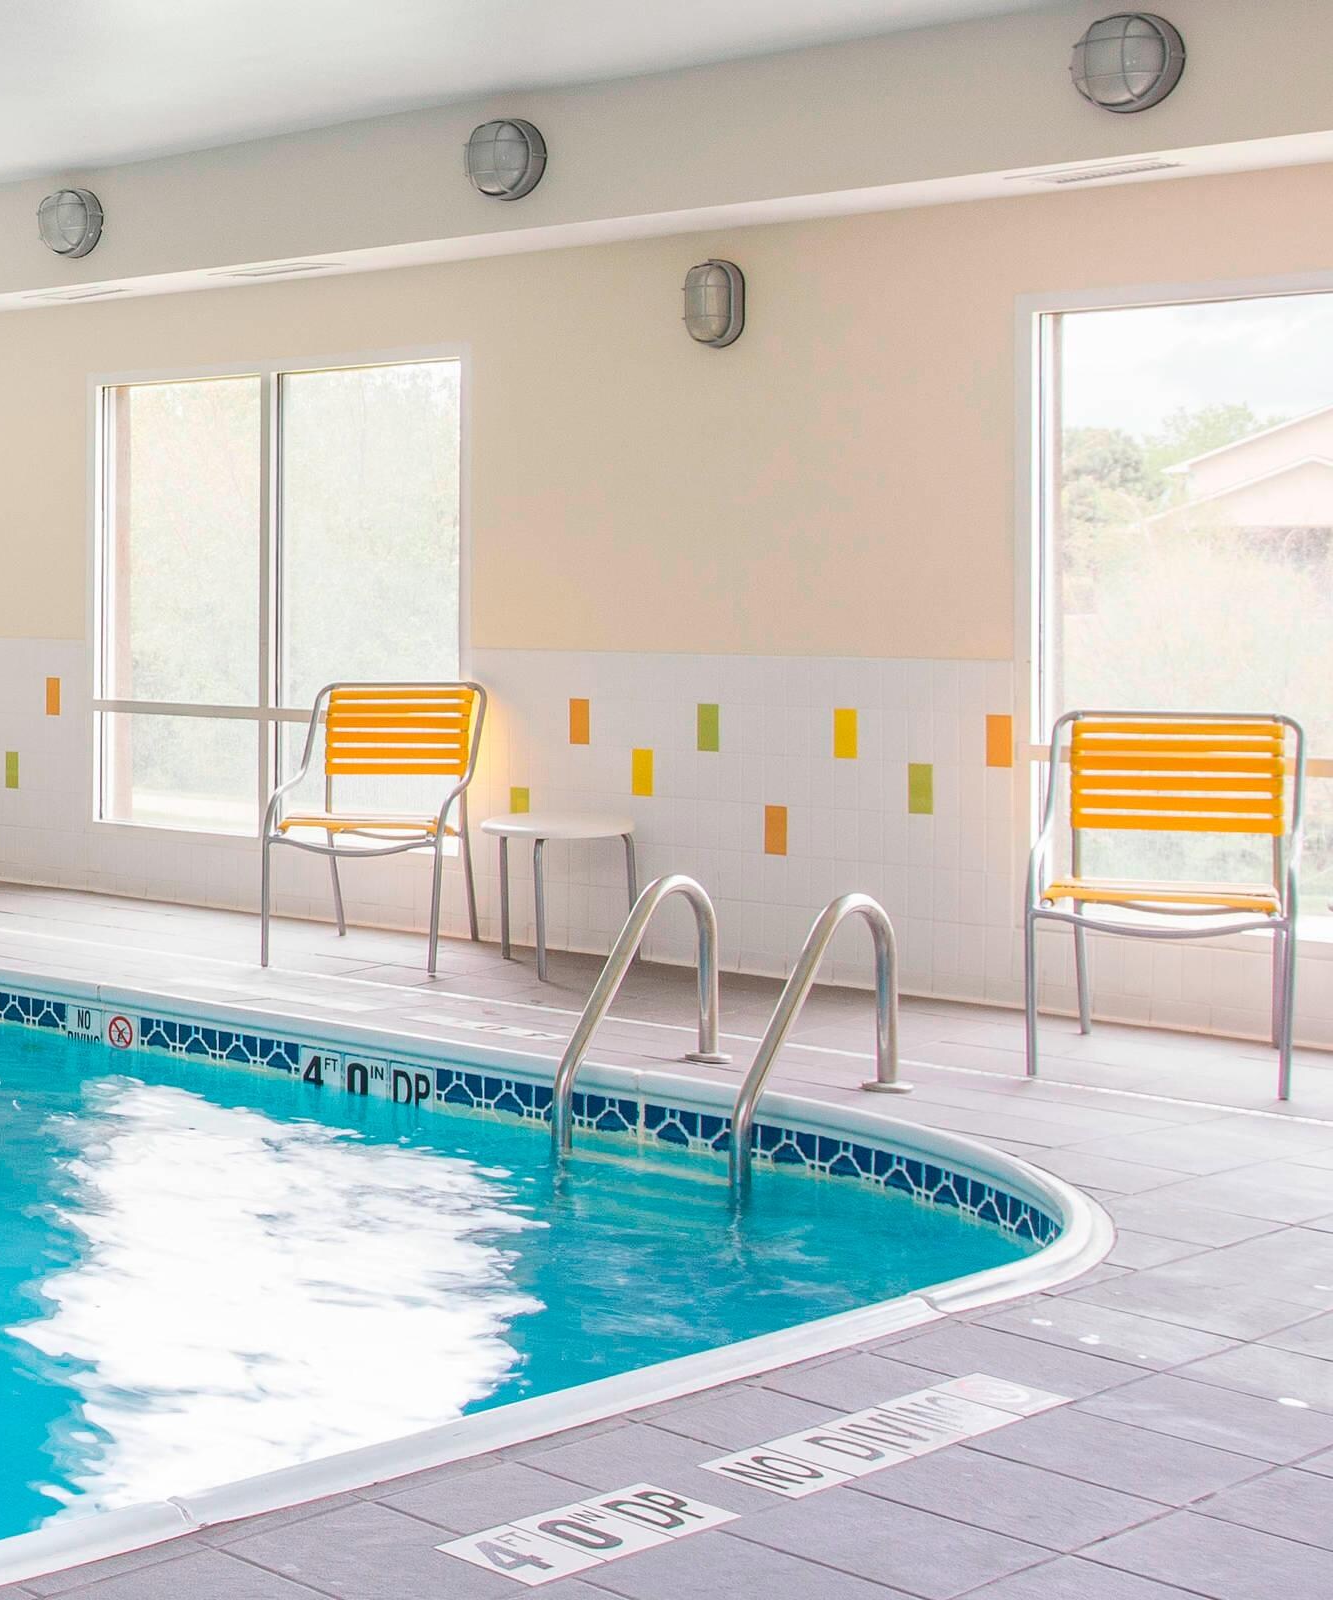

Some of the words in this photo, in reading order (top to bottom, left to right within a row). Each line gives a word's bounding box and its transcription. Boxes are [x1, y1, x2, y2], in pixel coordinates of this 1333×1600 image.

[77, 1009, 91, 1030] NO
[303, 1056, 324, 1085] 4
[324, 1058, 338, 1072] FT
[370, 1065, 384, 1080] IN
[393, 1069, 431, 1108] DP
[720, 1456, 824, 1489] NO
[567, 1509, 606, 1524] IN
[600, 1490, 705, 1529] DP
[494, 1531, 535, 1547] FT
[538, 1519, 623, 1549] 0
[474, 1540, 554, 1571] 4
